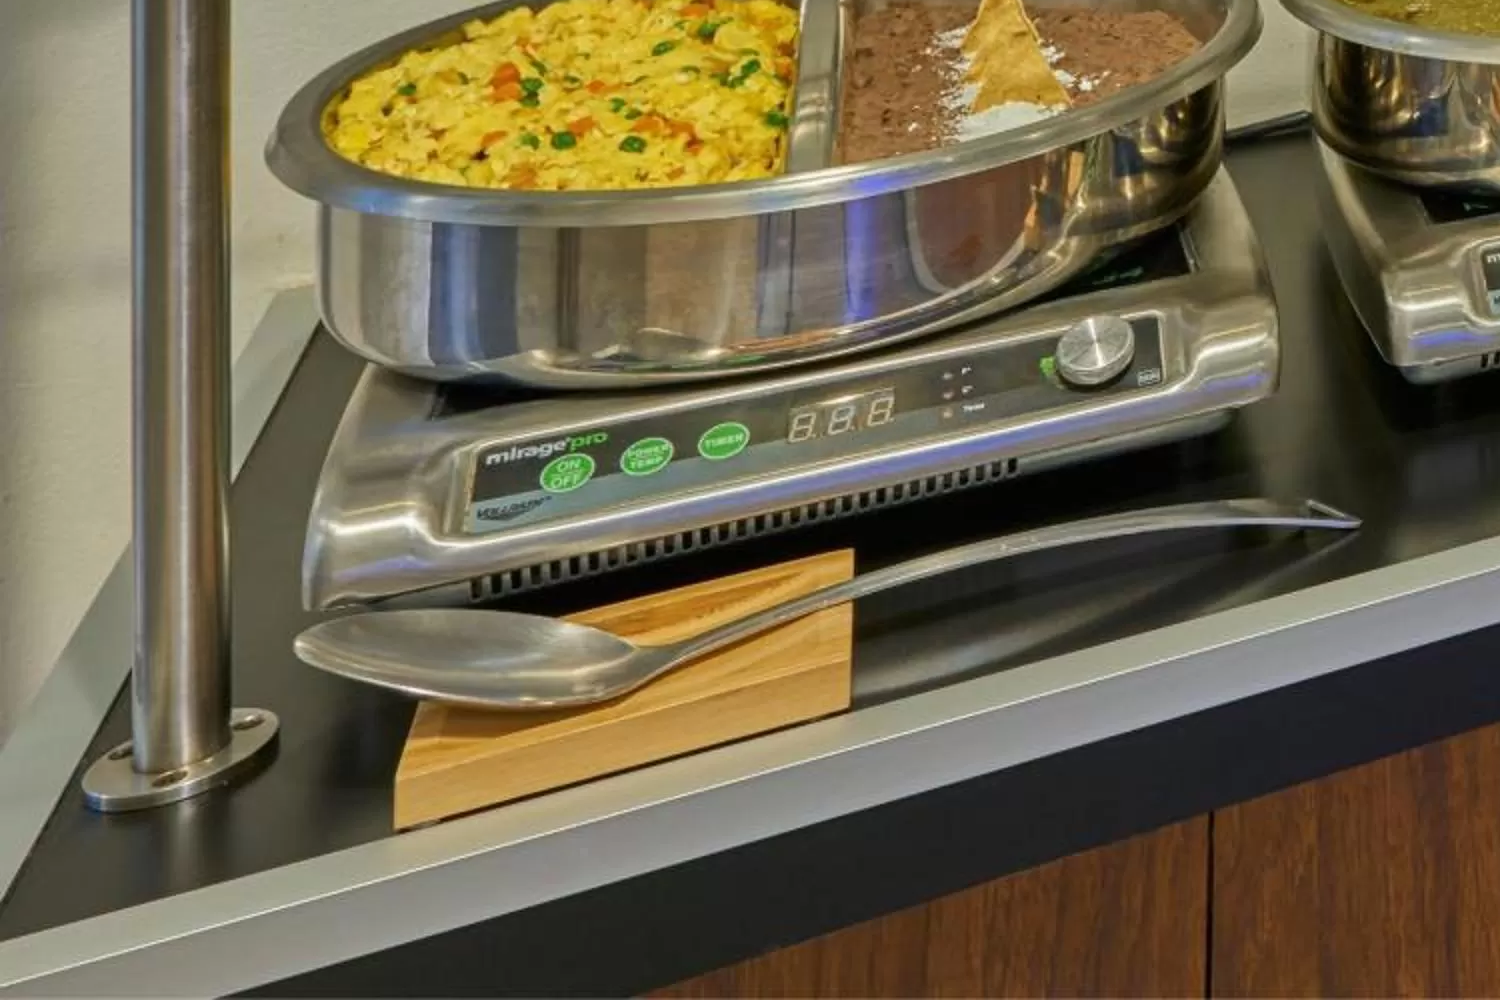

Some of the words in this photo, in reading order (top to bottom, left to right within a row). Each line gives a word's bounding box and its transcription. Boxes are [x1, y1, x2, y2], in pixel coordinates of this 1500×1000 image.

[704, 432, 745, 450] TIMER
[556, 459, 582, 473] ON
[549, 473, 579, 489] OFF
